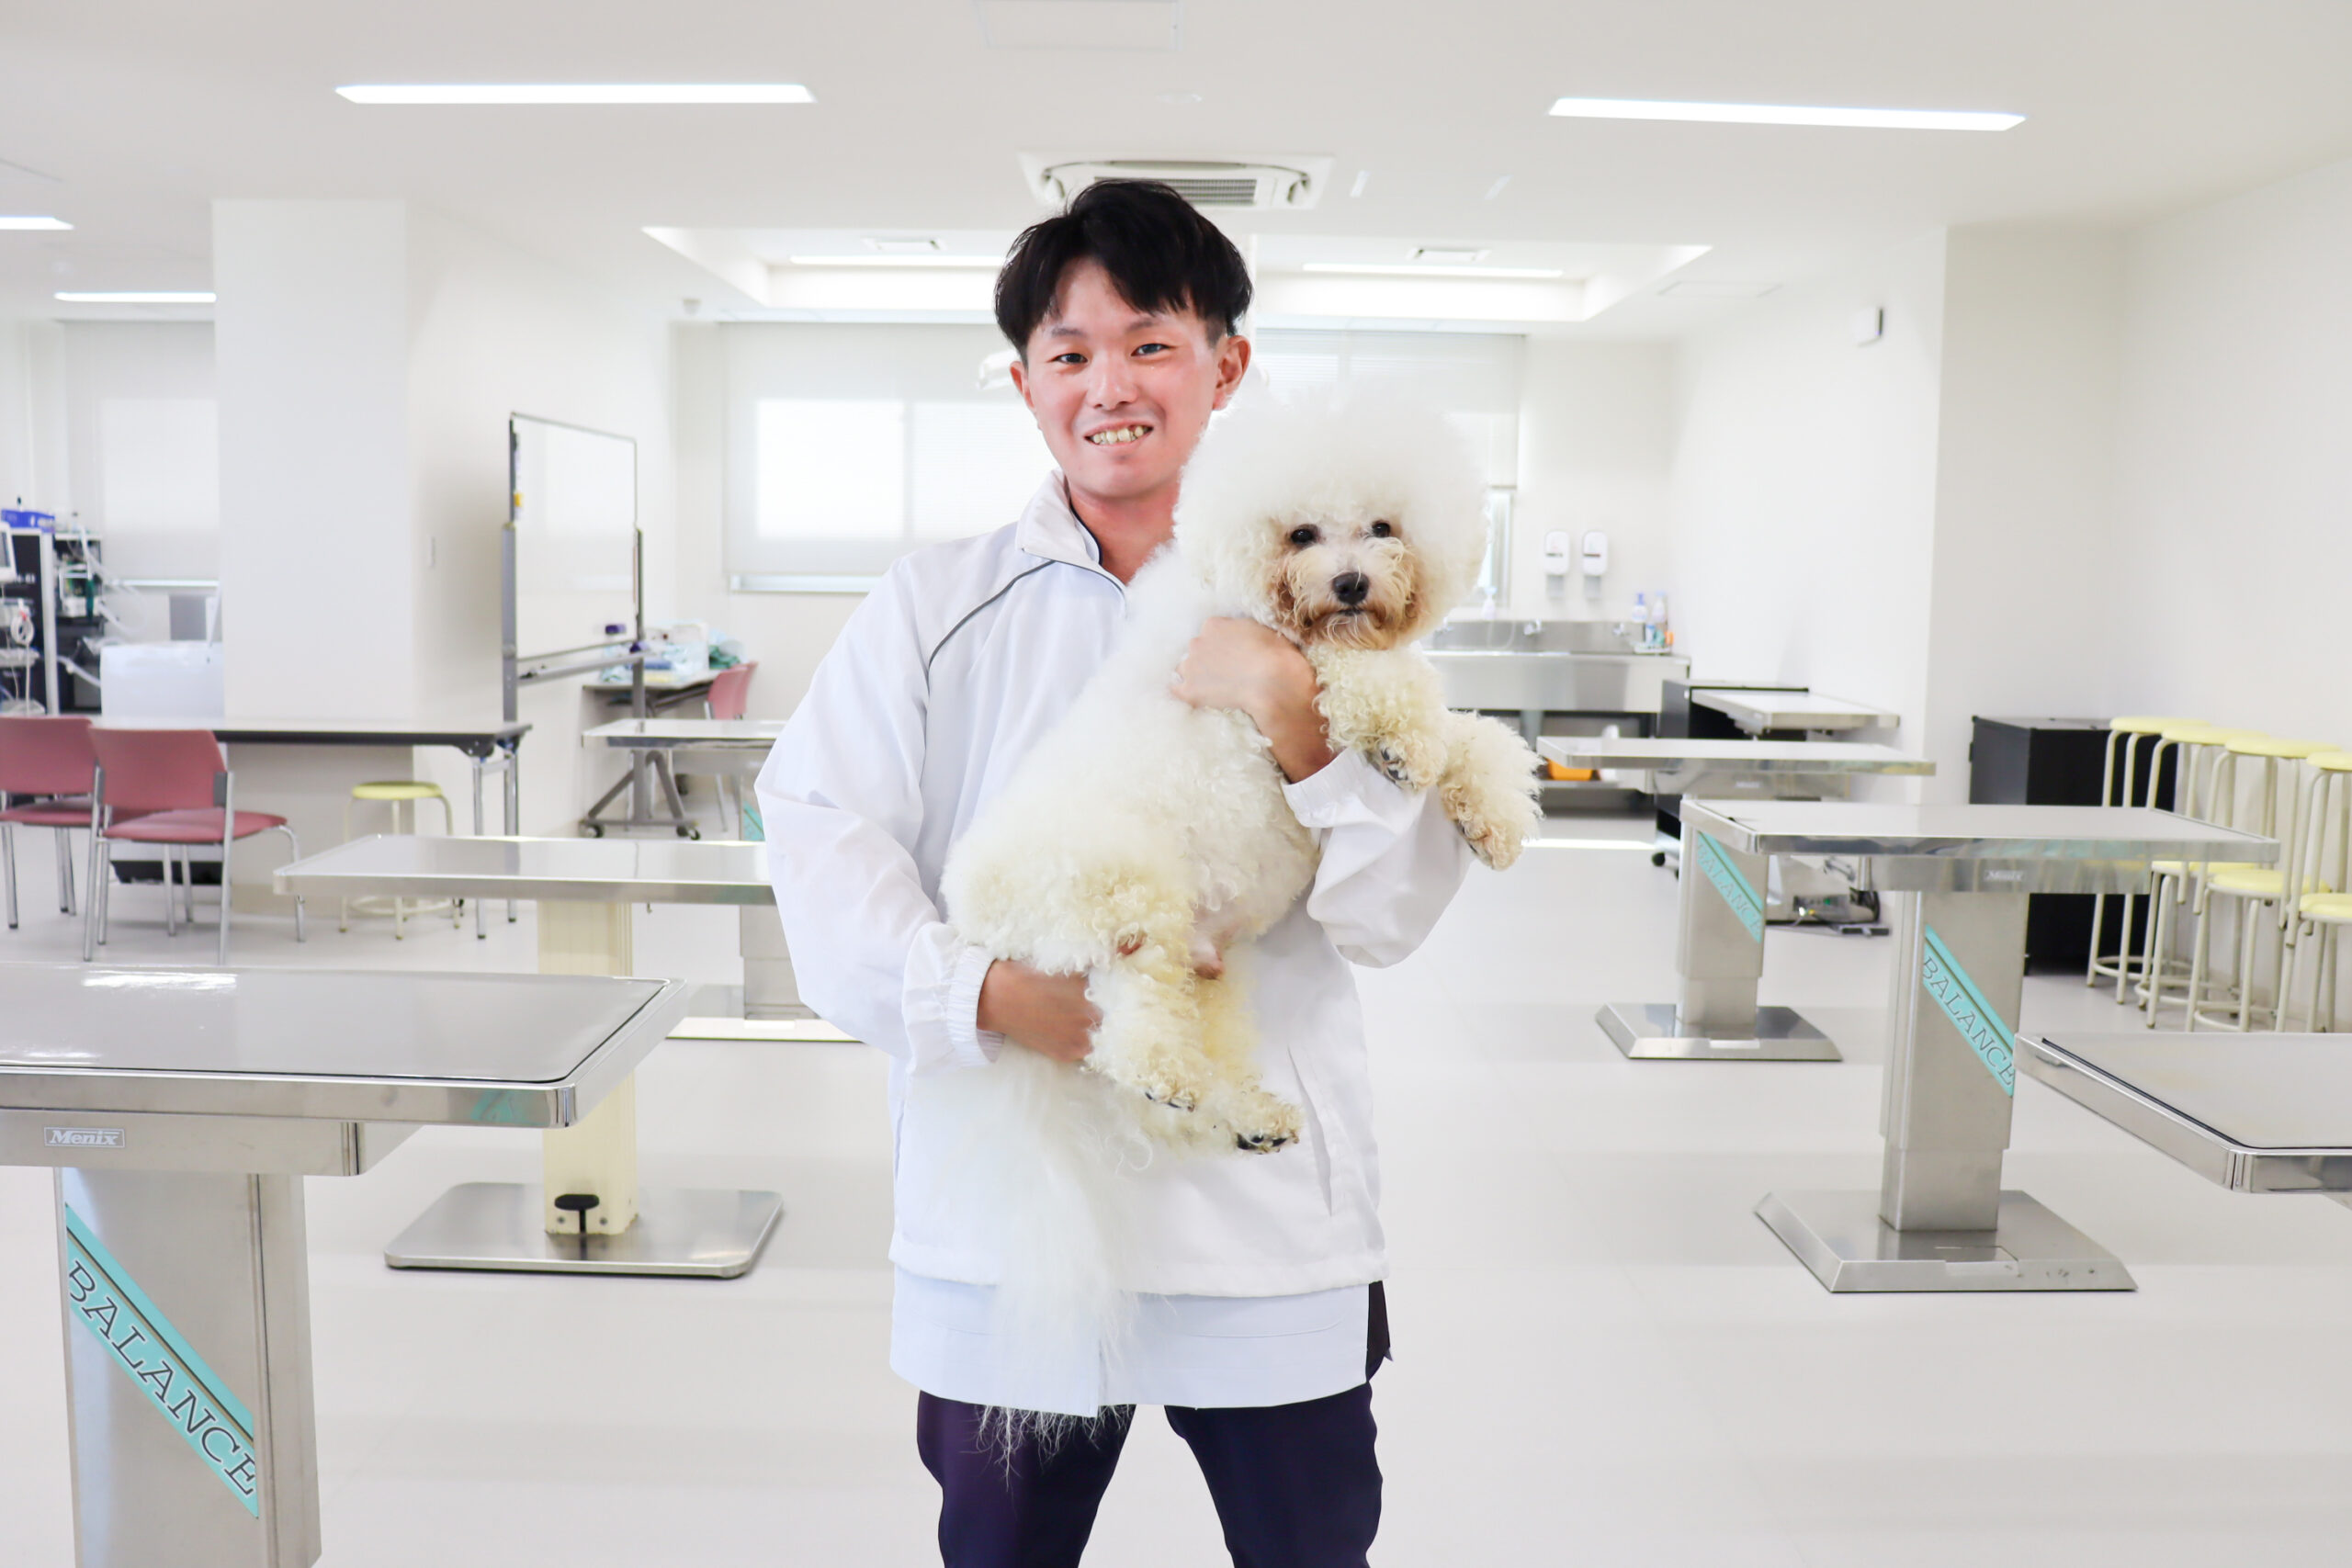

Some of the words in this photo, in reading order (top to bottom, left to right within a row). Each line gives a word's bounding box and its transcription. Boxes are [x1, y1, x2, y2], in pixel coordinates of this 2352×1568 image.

[1923, 956, 2016, 1086] BALANCE
[49, 1130, 120, 1145] Menix
[68, 1259, 255, 1496] BALANCE
